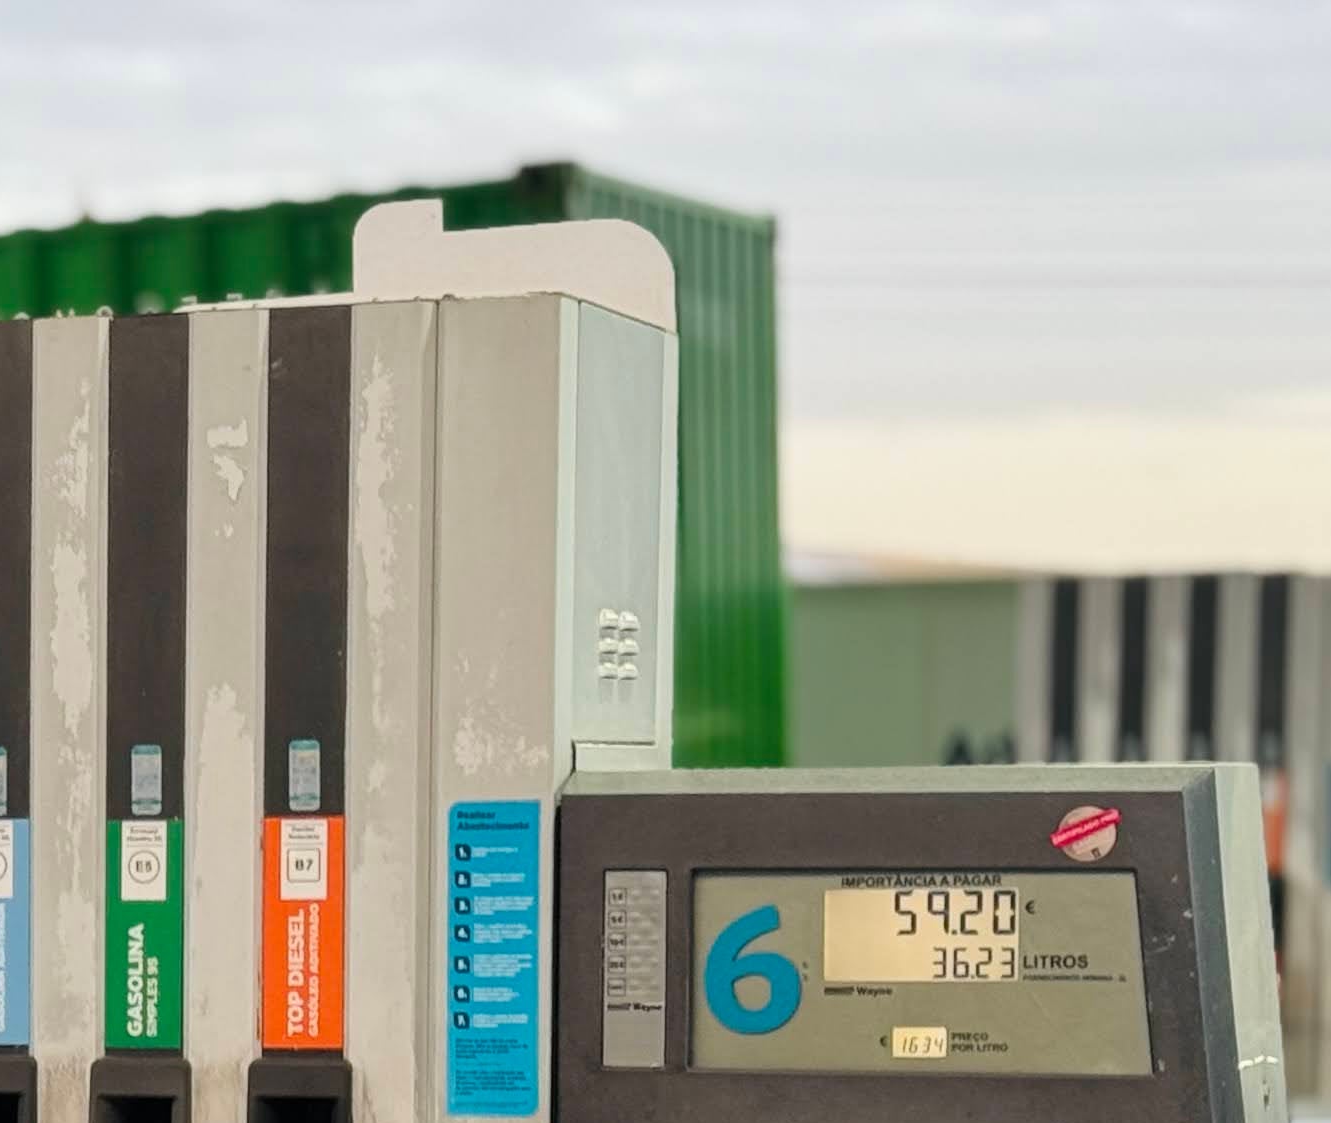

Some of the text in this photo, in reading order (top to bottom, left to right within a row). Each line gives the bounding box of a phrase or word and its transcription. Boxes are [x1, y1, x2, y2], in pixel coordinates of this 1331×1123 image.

[295, 859, 314, 870] B7
[841, 873, 1003, 889] IMPORTÂNCIA A PAGAR
[894, 890, 1036, 935] 59.20 €
[126, 923, 144, 1037] GASOLINA
[287, 909, 305, 1037] TOP DIESEL
[705, 905, 802, 1035] 6
[933, 947, 1089, 979] 36.23 LITROS
[146, 957, 159, 1037] SIMPLES 95
